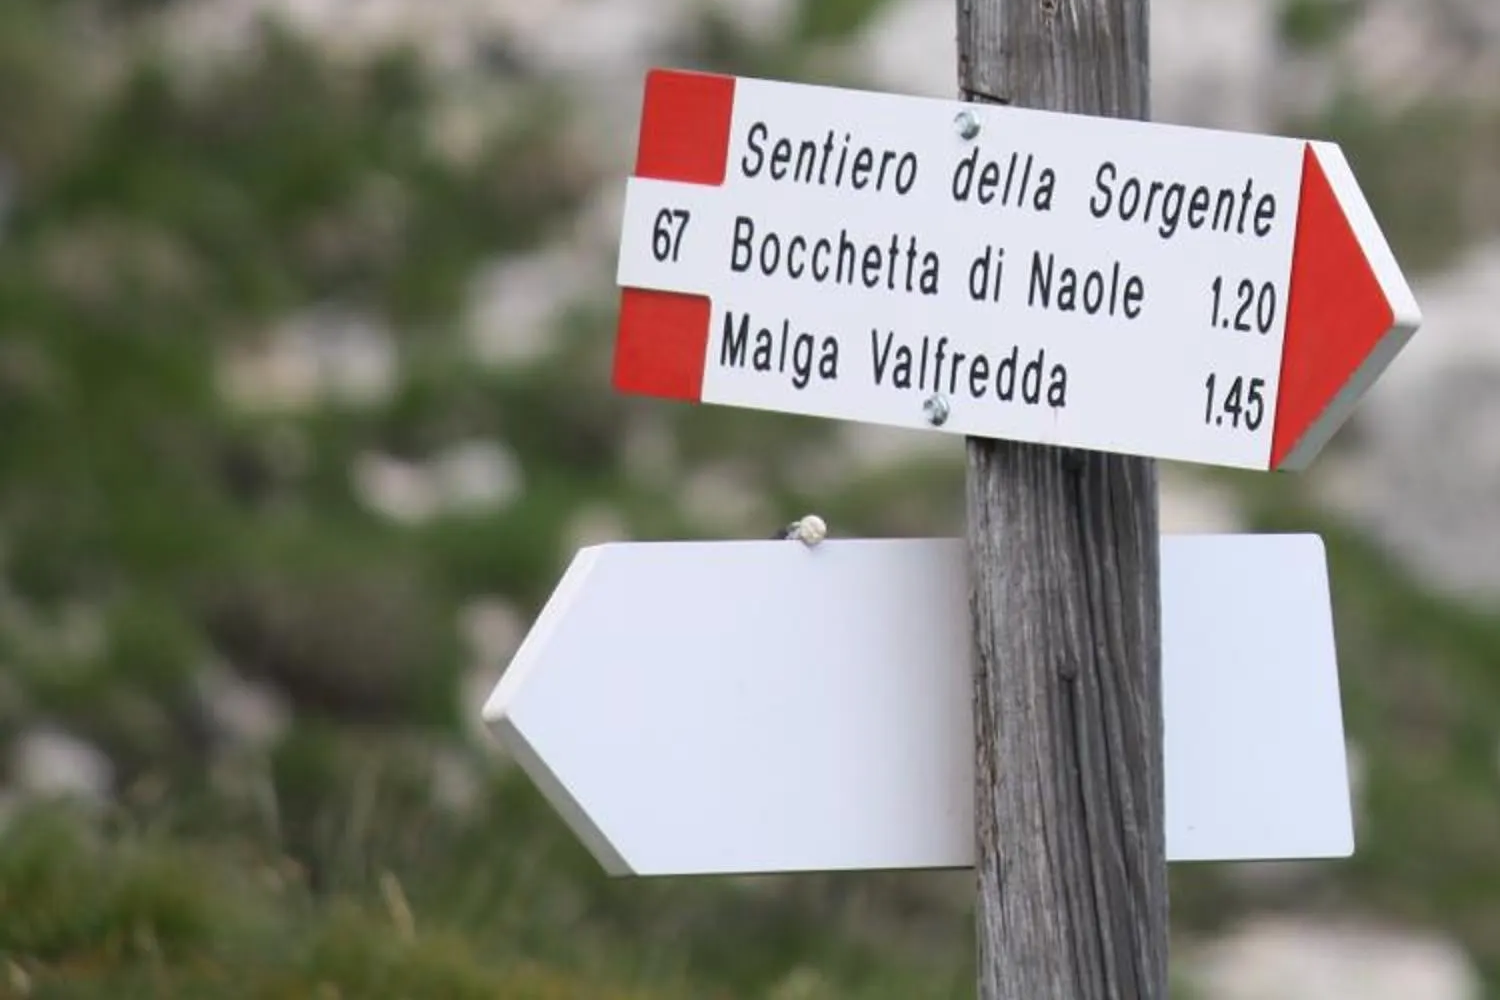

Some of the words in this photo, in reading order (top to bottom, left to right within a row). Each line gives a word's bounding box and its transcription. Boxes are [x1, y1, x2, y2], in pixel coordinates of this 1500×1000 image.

[651, 206, 692, 263] 67
[740, 121, 918, 196] Sentiero
[951, 145, 1057, 212] della
[1088, 160, 1277, 239] Sorgente
[729, 214, 940, 296] Bocchetta
[968, 244, 1004, 303] di
[1027, 250, 1145, 321] Naole
[1210, 275, 1277, 336] 1.20
[720, 310, 840, 391] Malga
[870, 328, 1068, 409] Valfredda
[1204, 372, 1266, 433] 1.45
